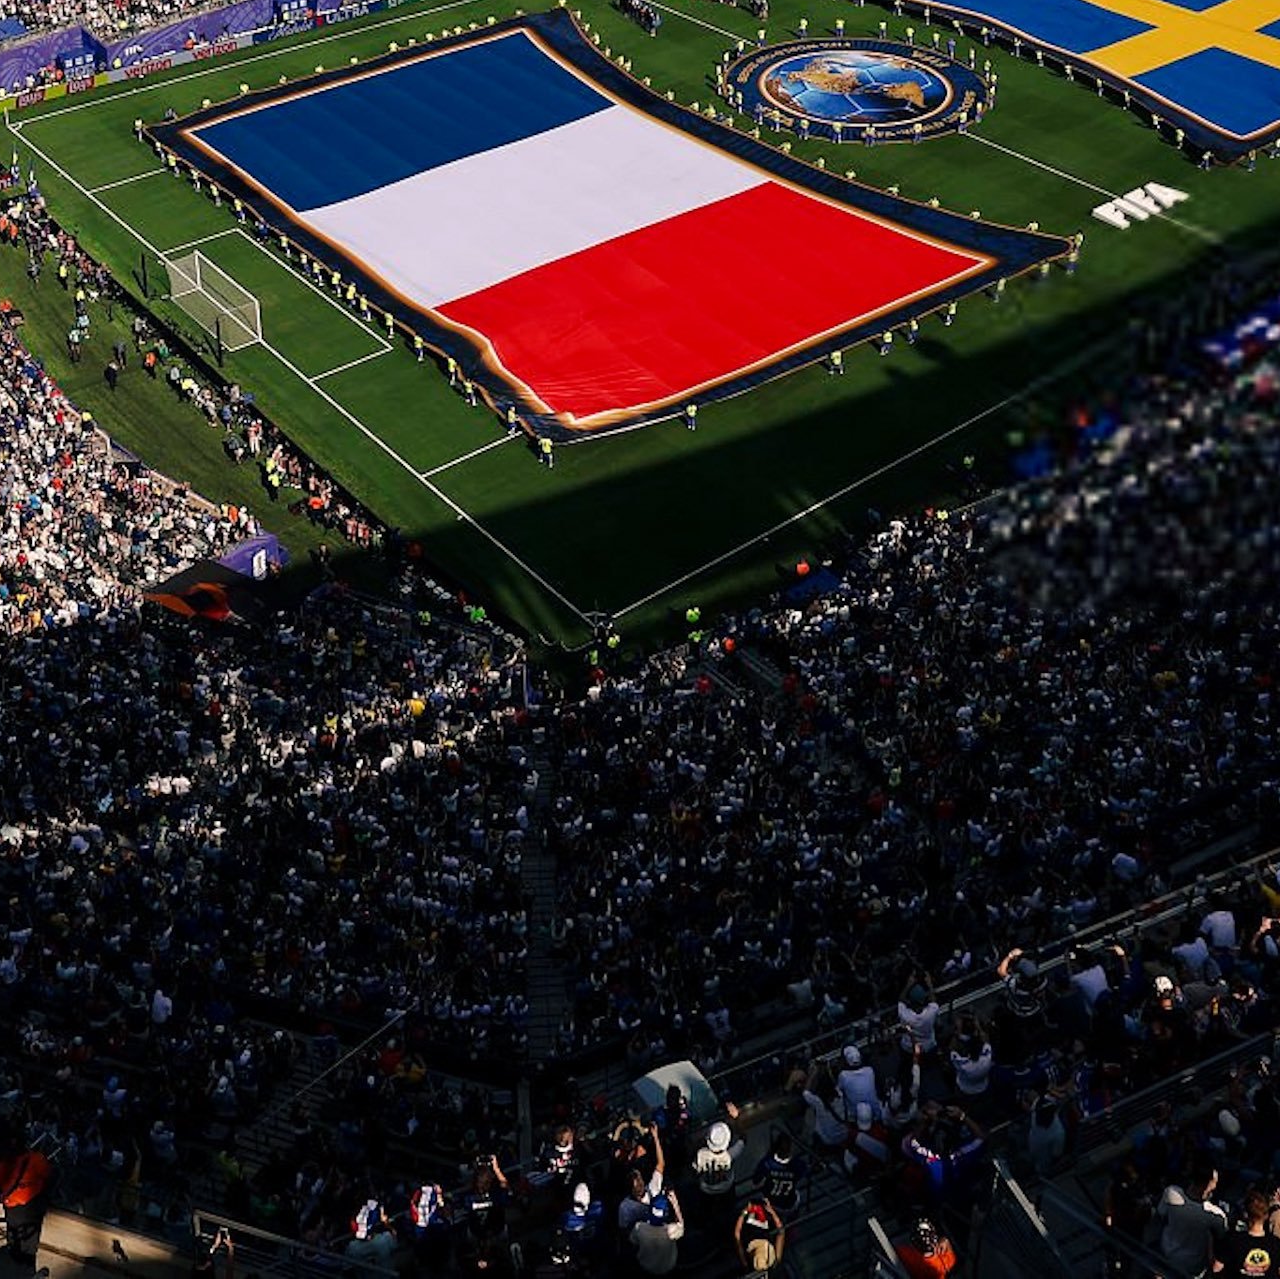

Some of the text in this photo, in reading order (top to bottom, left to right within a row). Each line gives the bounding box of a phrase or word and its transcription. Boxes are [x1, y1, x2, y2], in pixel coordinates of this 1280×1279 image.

[325, 4, 370, 25] ULTRA
[192, 41, 238, 60] verizon
[125, 58, 172, 78] verizon
[1091, 182, 1190, 230] FIFA
